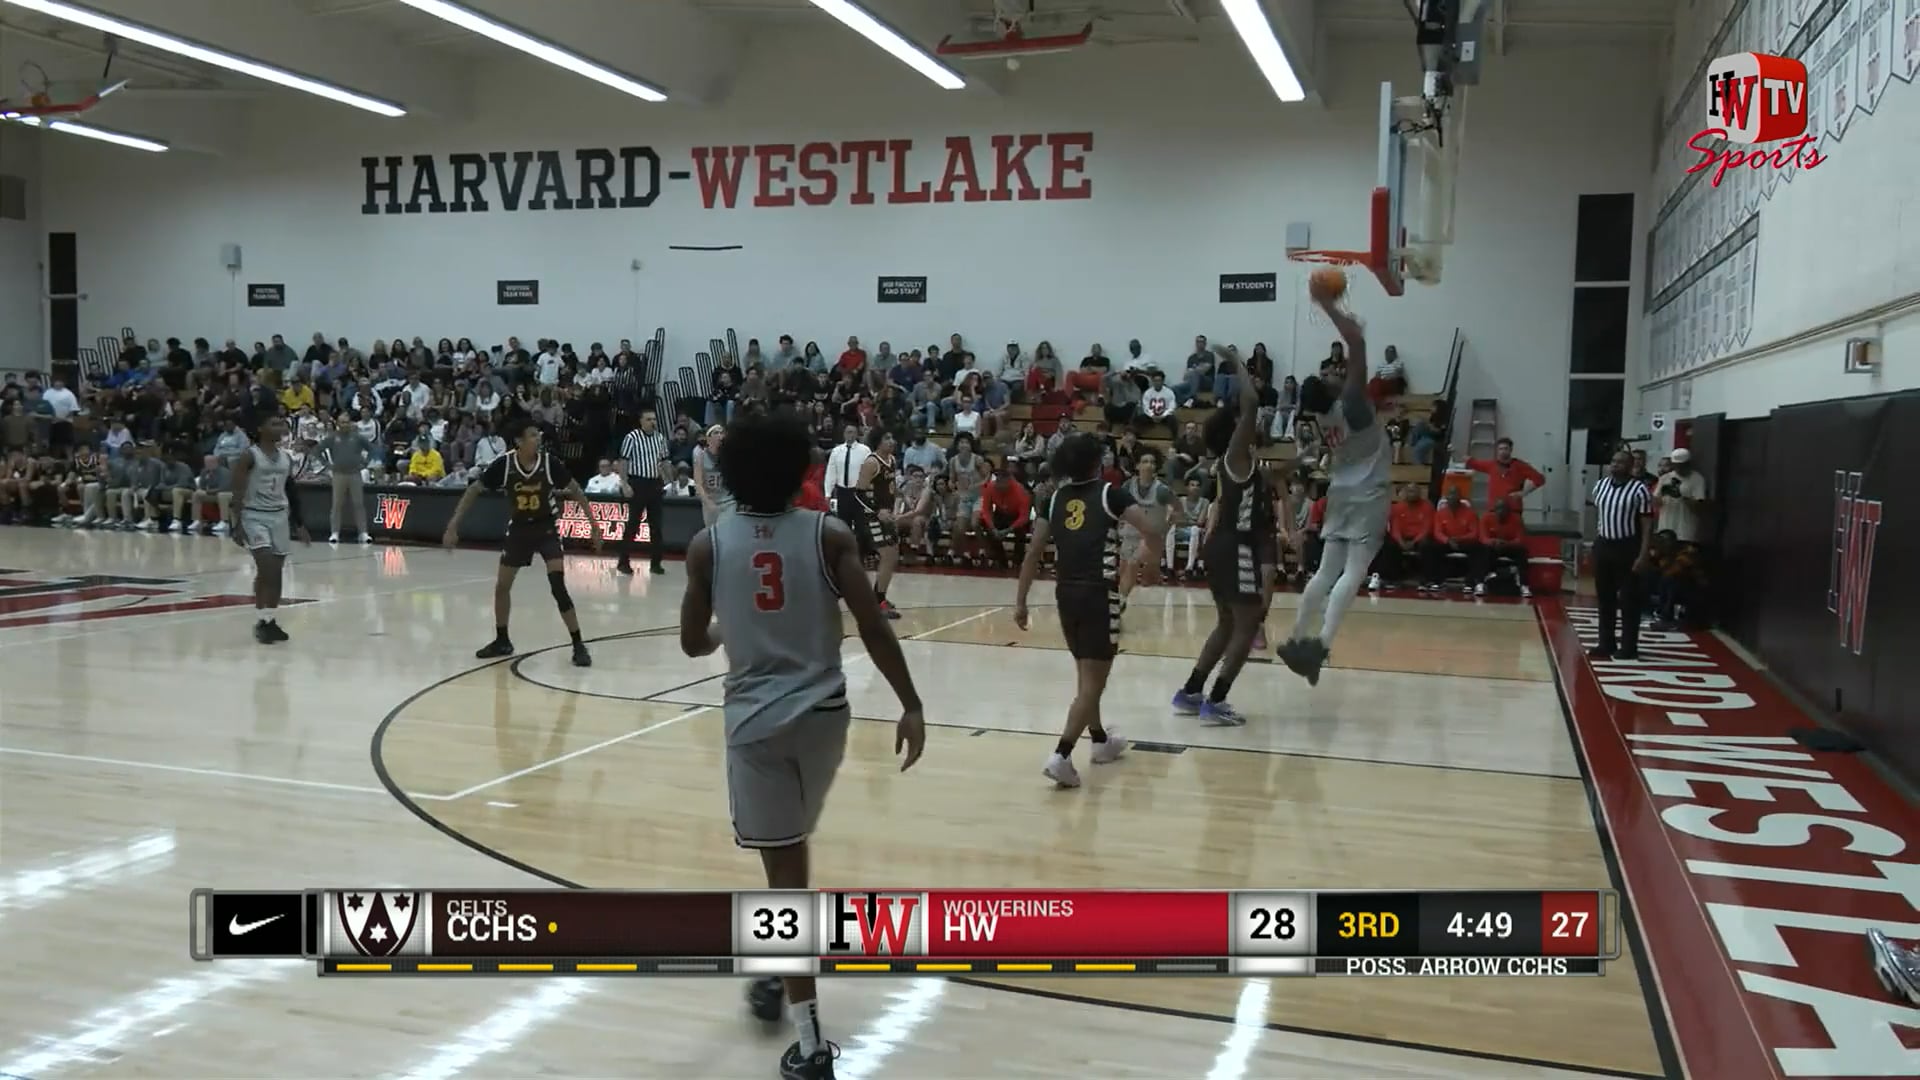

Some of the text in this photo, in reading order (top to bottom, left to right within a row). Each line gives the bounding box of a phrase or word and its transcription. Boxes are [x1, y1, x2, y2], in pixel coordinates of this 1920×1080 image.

[361, 132, 1094, 215] HARVARD-WESTLAKE
[1222, 281, 1273, 290] HW STUDENTS
[374, 493, 409, 529] HW
[1065, 499, 1086, 530] 3
[751, 551, 785, 613] 3
